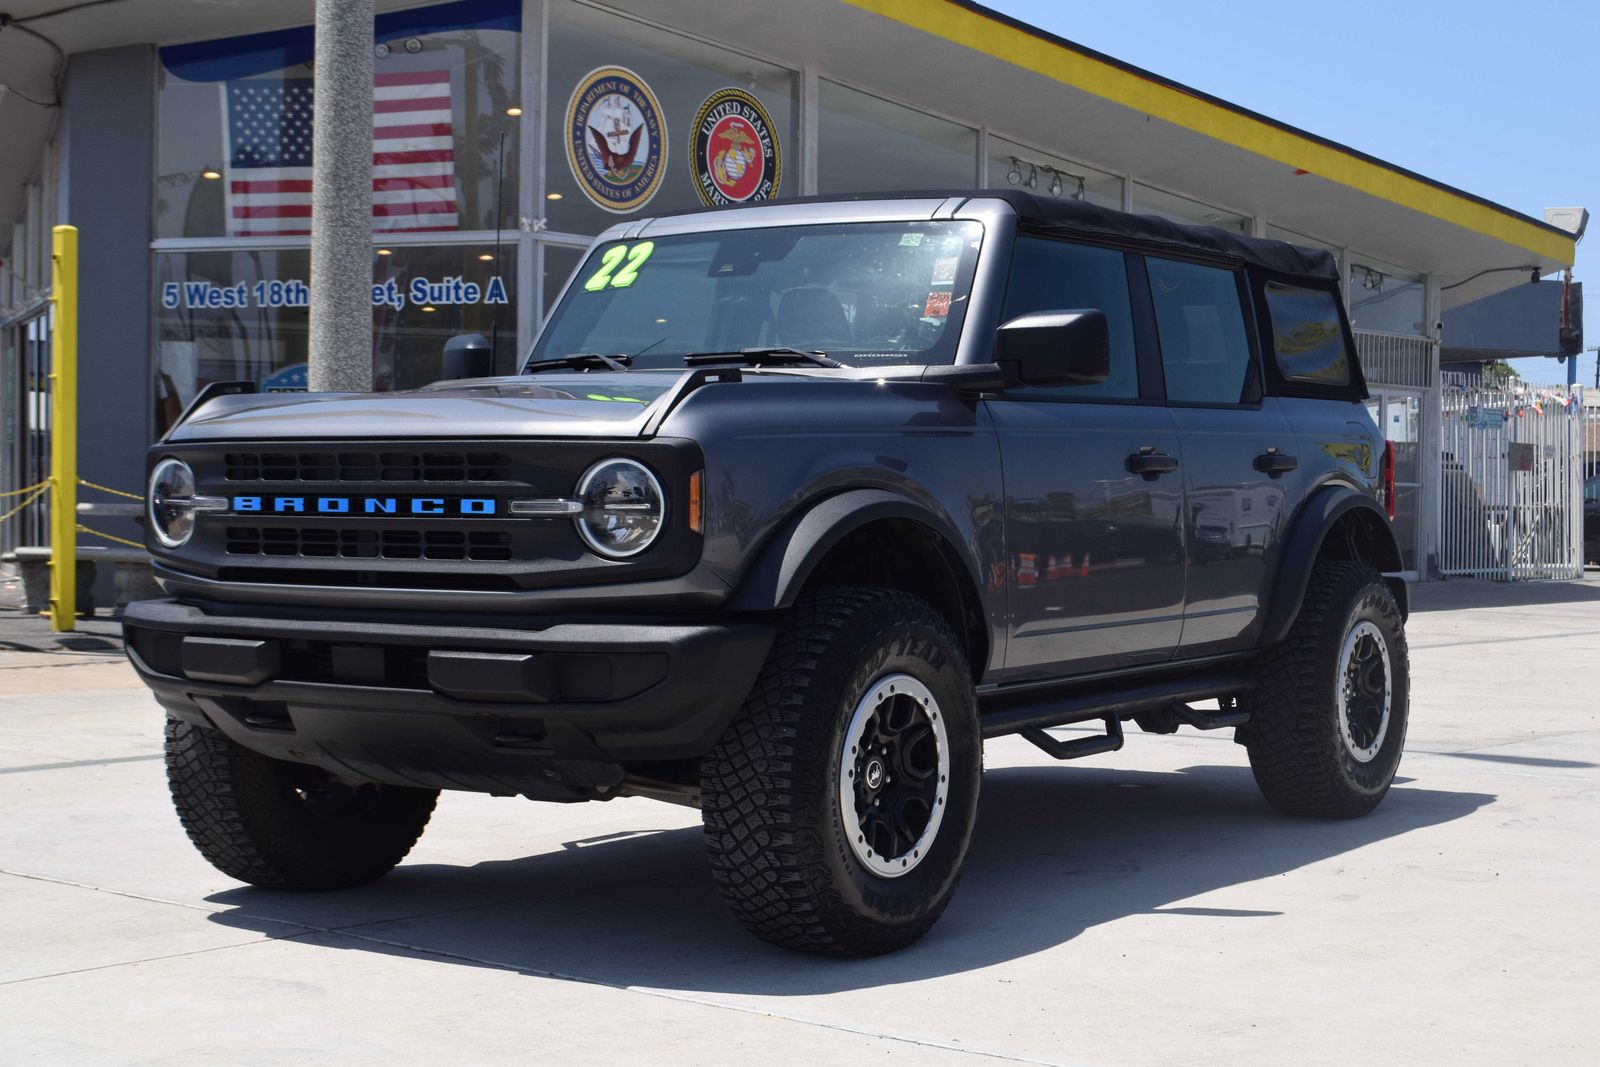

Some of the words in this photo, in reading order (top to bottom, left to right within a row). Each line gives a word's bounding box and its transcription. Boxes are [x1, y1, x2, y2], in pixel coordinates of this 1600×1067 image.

[577, 81, 618, 126] DEPARTMENT
[620, 83, 632, 95] OF
[633, 91, 648, 110] THE
[643, 108, 659, 137] NAVY
[700, 101, 741, 135] UNITED
[741, 105, 774, 158] STATES
[575, 140, 595, 180] UNITED
[592, 178, 621, 198] STATES
[621, 187, 634, 198] OF
[633, 155, 658, 192] AMERICA
[700, 172, 729, 206] MAR
[163, 281, 180, 309] 5
[183, 280, 249, 308] West
[252, 279, 310, 307] 18th
[409, 275, 482, 305] Suite
[483, 276, 509, 304] A
[584, 241, 655, 292] 22
[233, 496, 496, 515] BRONCO
